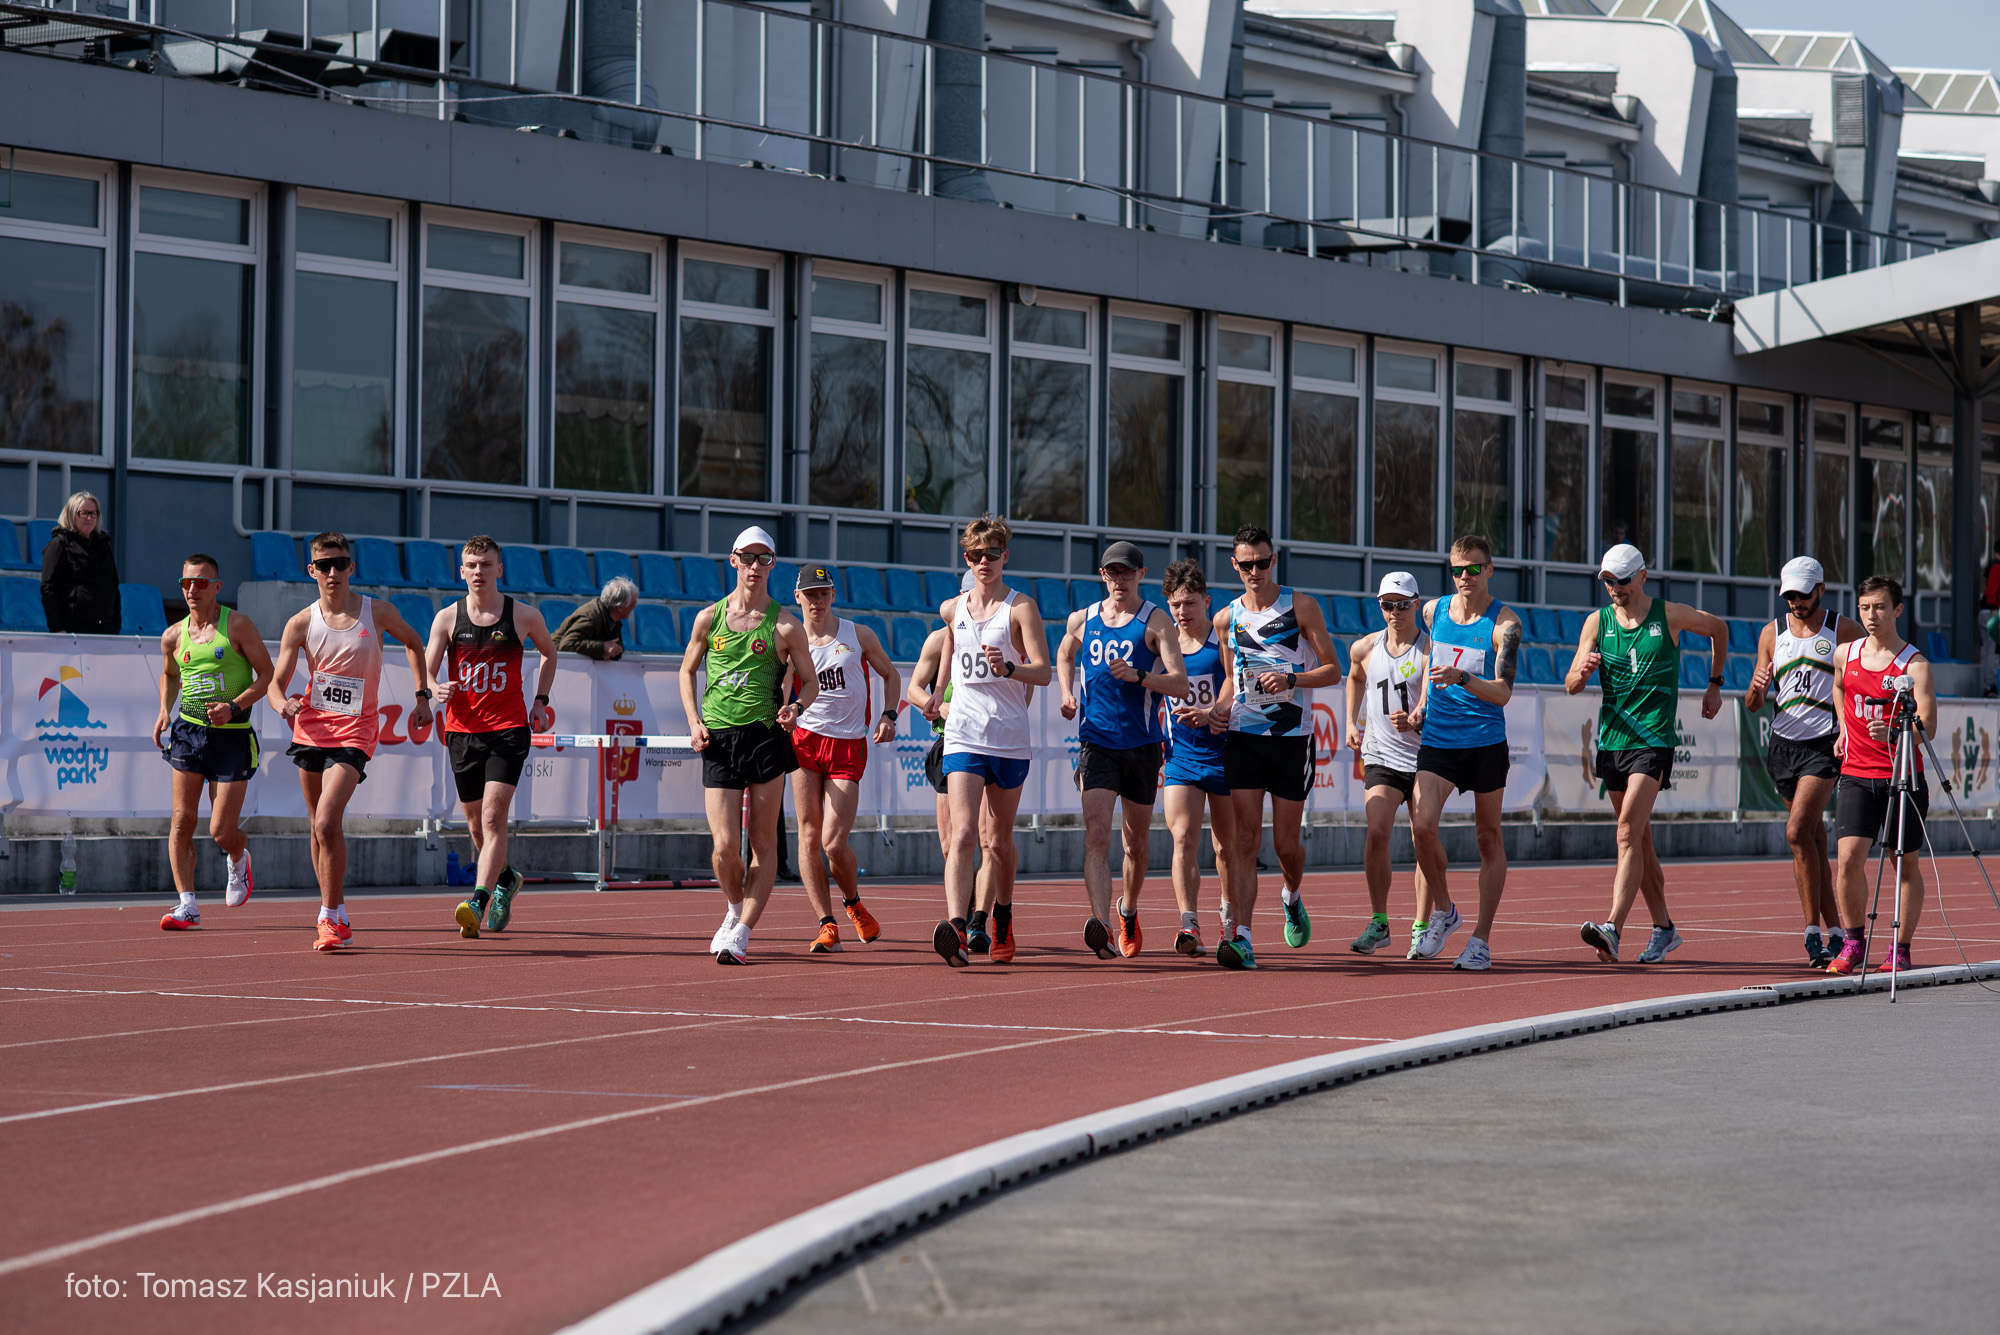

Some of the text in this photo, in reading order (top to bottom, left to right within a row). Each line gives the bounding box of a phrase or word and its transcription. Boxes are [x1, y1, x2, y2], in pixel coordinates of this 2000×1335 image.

[1089, 638, 1134, 667] 962
[1452, 647, 1464, 669] 7
[1627, 647, 1638, 674] 1
[189, 671, 226, 695] 551
[457, 660, 507, 694] 905
[818, 666, 846, 692] 984
[1794, 670, 1812, 693] 24
[322, 686, 352, 705] 498
[1376, 677, 1410, 716] 11
[44, 741, 109, 772] wodny
[524, 759, 553, 778] olski
[645, 758, 682, 767] Warszawa
[57, 766, 97, 790] park
[906, 772, 934, 792] par
[1313, 772, 1335, 788] ZLA
